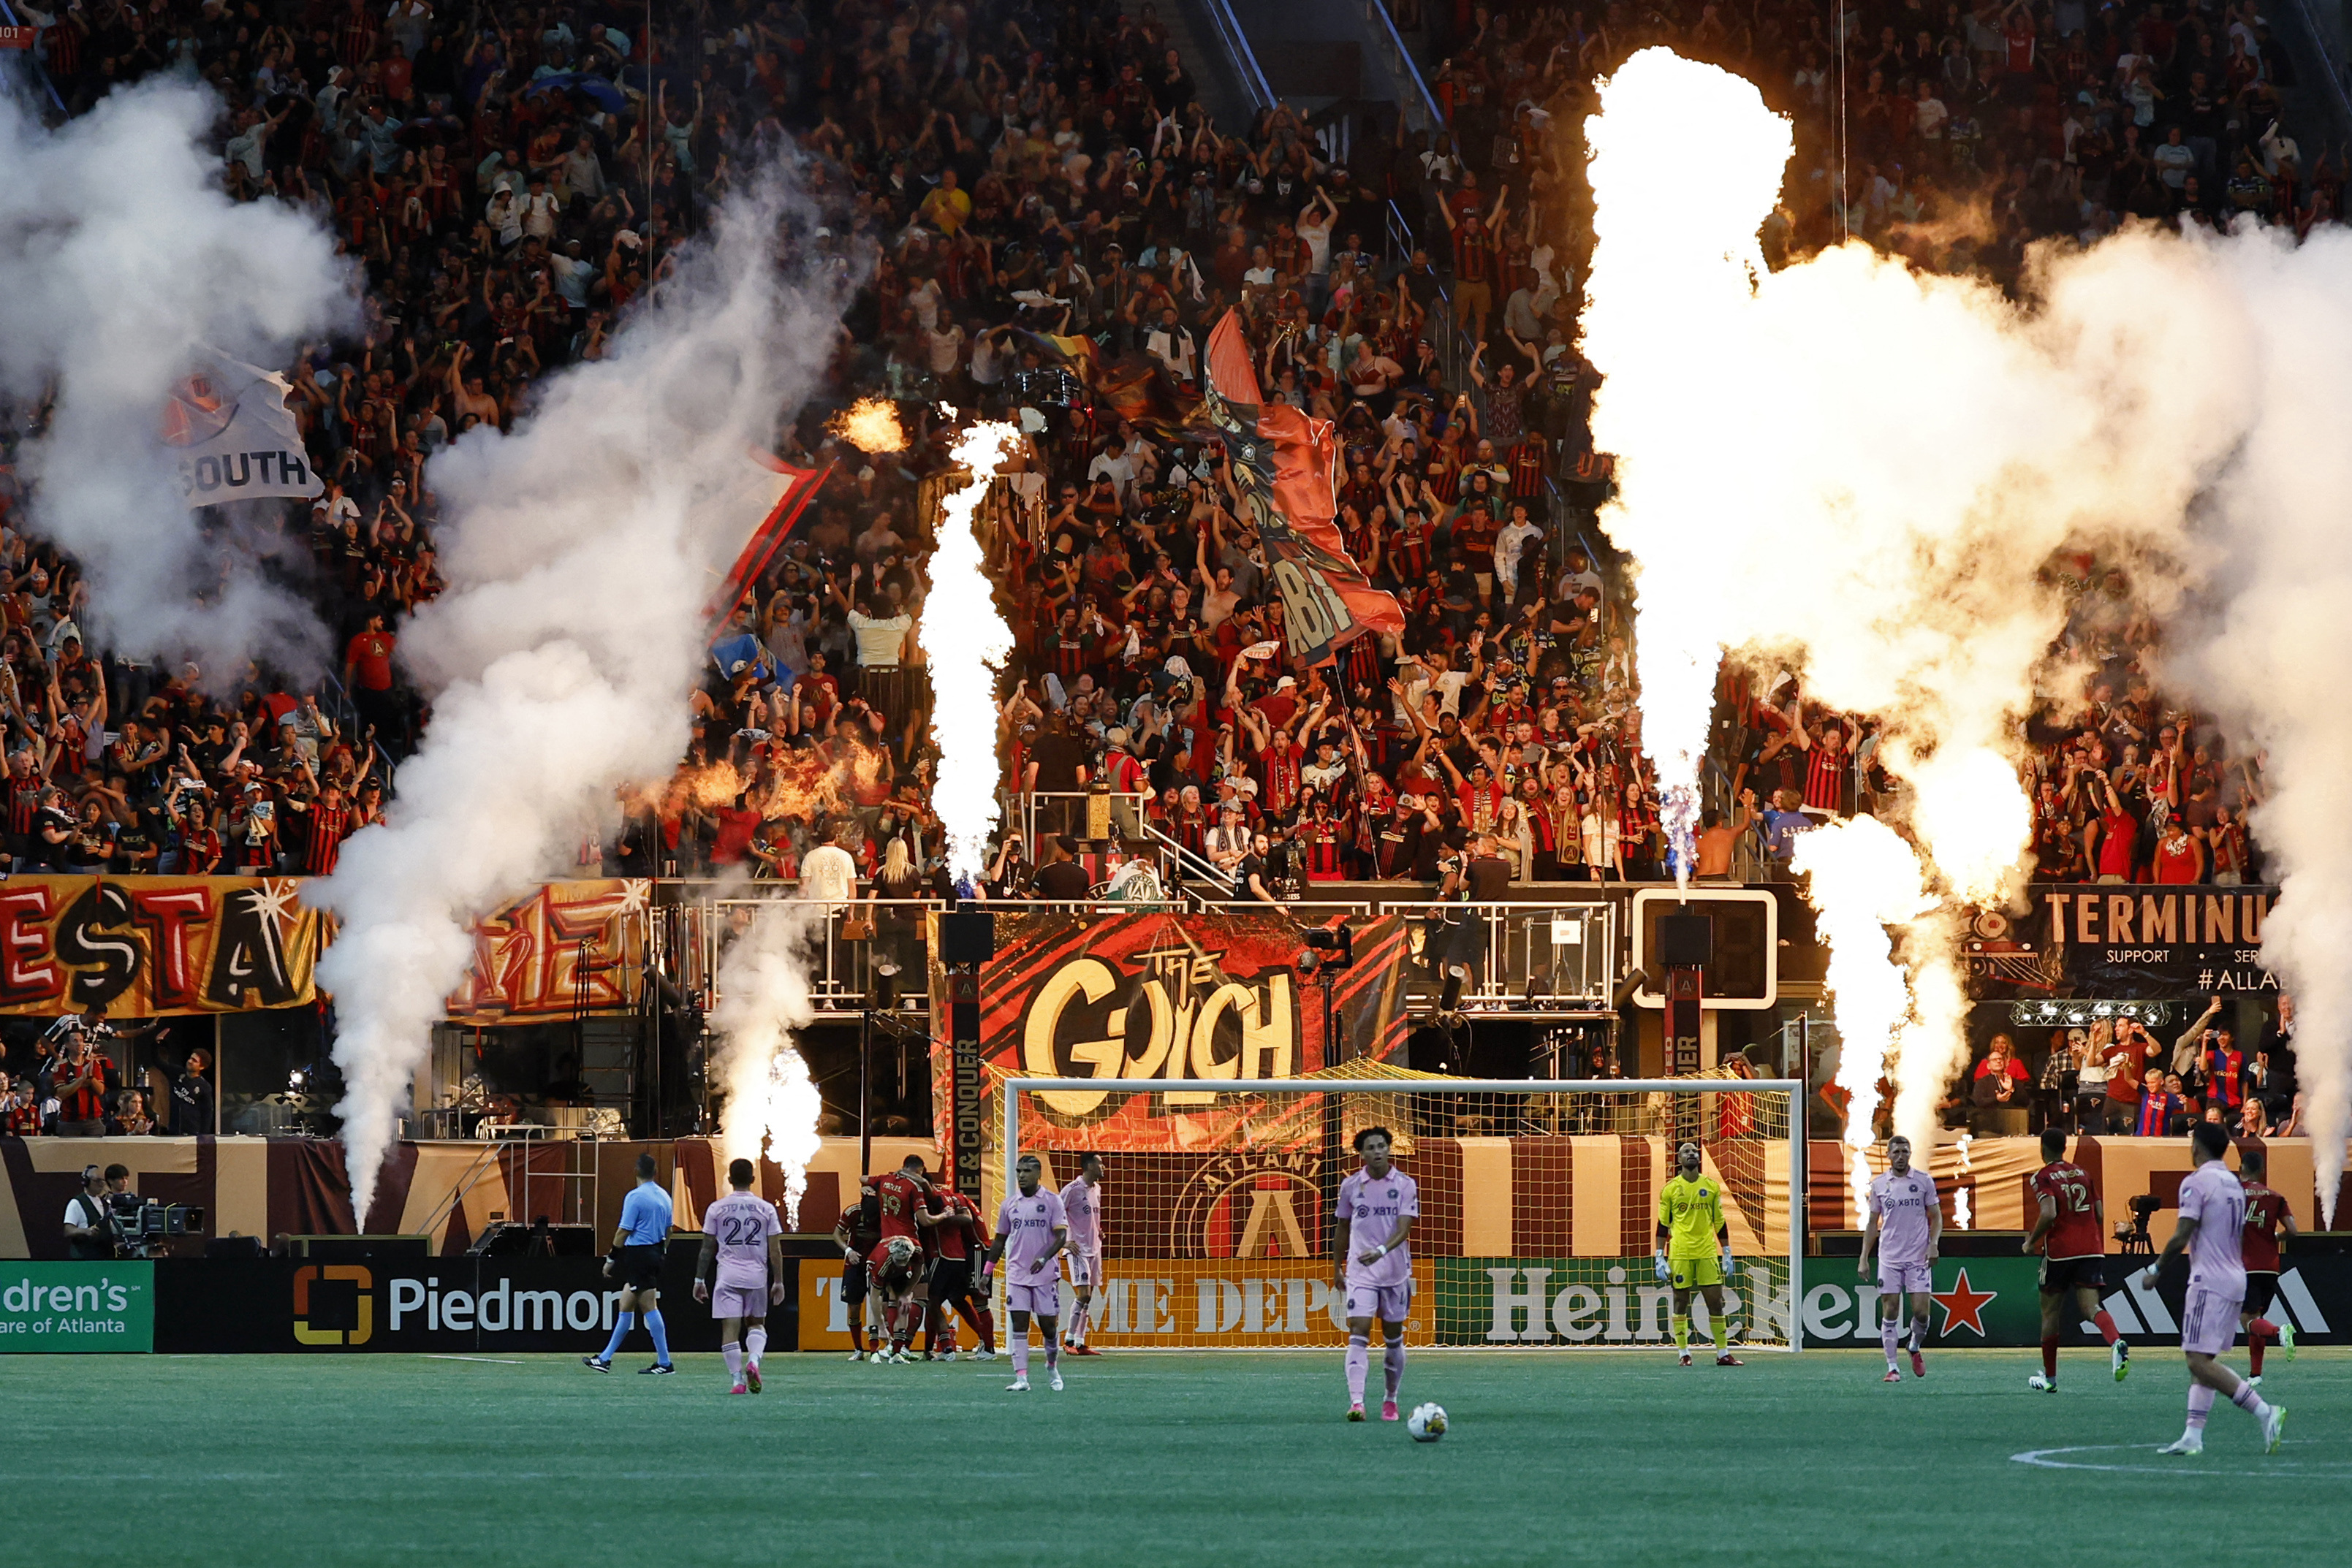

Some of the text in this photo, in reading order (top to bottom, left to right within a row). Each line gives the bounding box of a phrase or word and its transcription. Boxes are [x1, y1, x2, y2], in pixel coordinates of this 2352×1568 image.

[179, 451, 306, 495] SOUTH
[2045, 894, 2280, 943] TERMINU
[0, 883, 297, 1011] ESTA
[2106, 950, 2170, 963] SUPPORT
[1133, 948, 1223, 1011] THE
[1024, 959, 1294, 1116] GULCH
[956, 1039, 980, 1148] CONQUER
[1677, 1036, 1698, 1144] CONER
[1202, 1152, 1323, 1194] ATLANT
[881, 1192, 902, 1217] 19
[1373, 1206, 1398, 1216] XBTO
[1690, 1202, 1708, 1210] XBTO
[1898, 1198, 1920, 1206] XBTO
[2060, 1183, 2090, 1212] 12
[1024, 1219, 1047, 1228] XBTO
[2227, 1196, 2245, 1238] 11
[2245, 1200, 2266, 1229] 4
[722, 1216, 762, 1247] 22
[1916, 1267, 1927, 1281] 2
[32, 1317, 53, 1334] of
[57, 1317, 126, 1333] Atlanta
